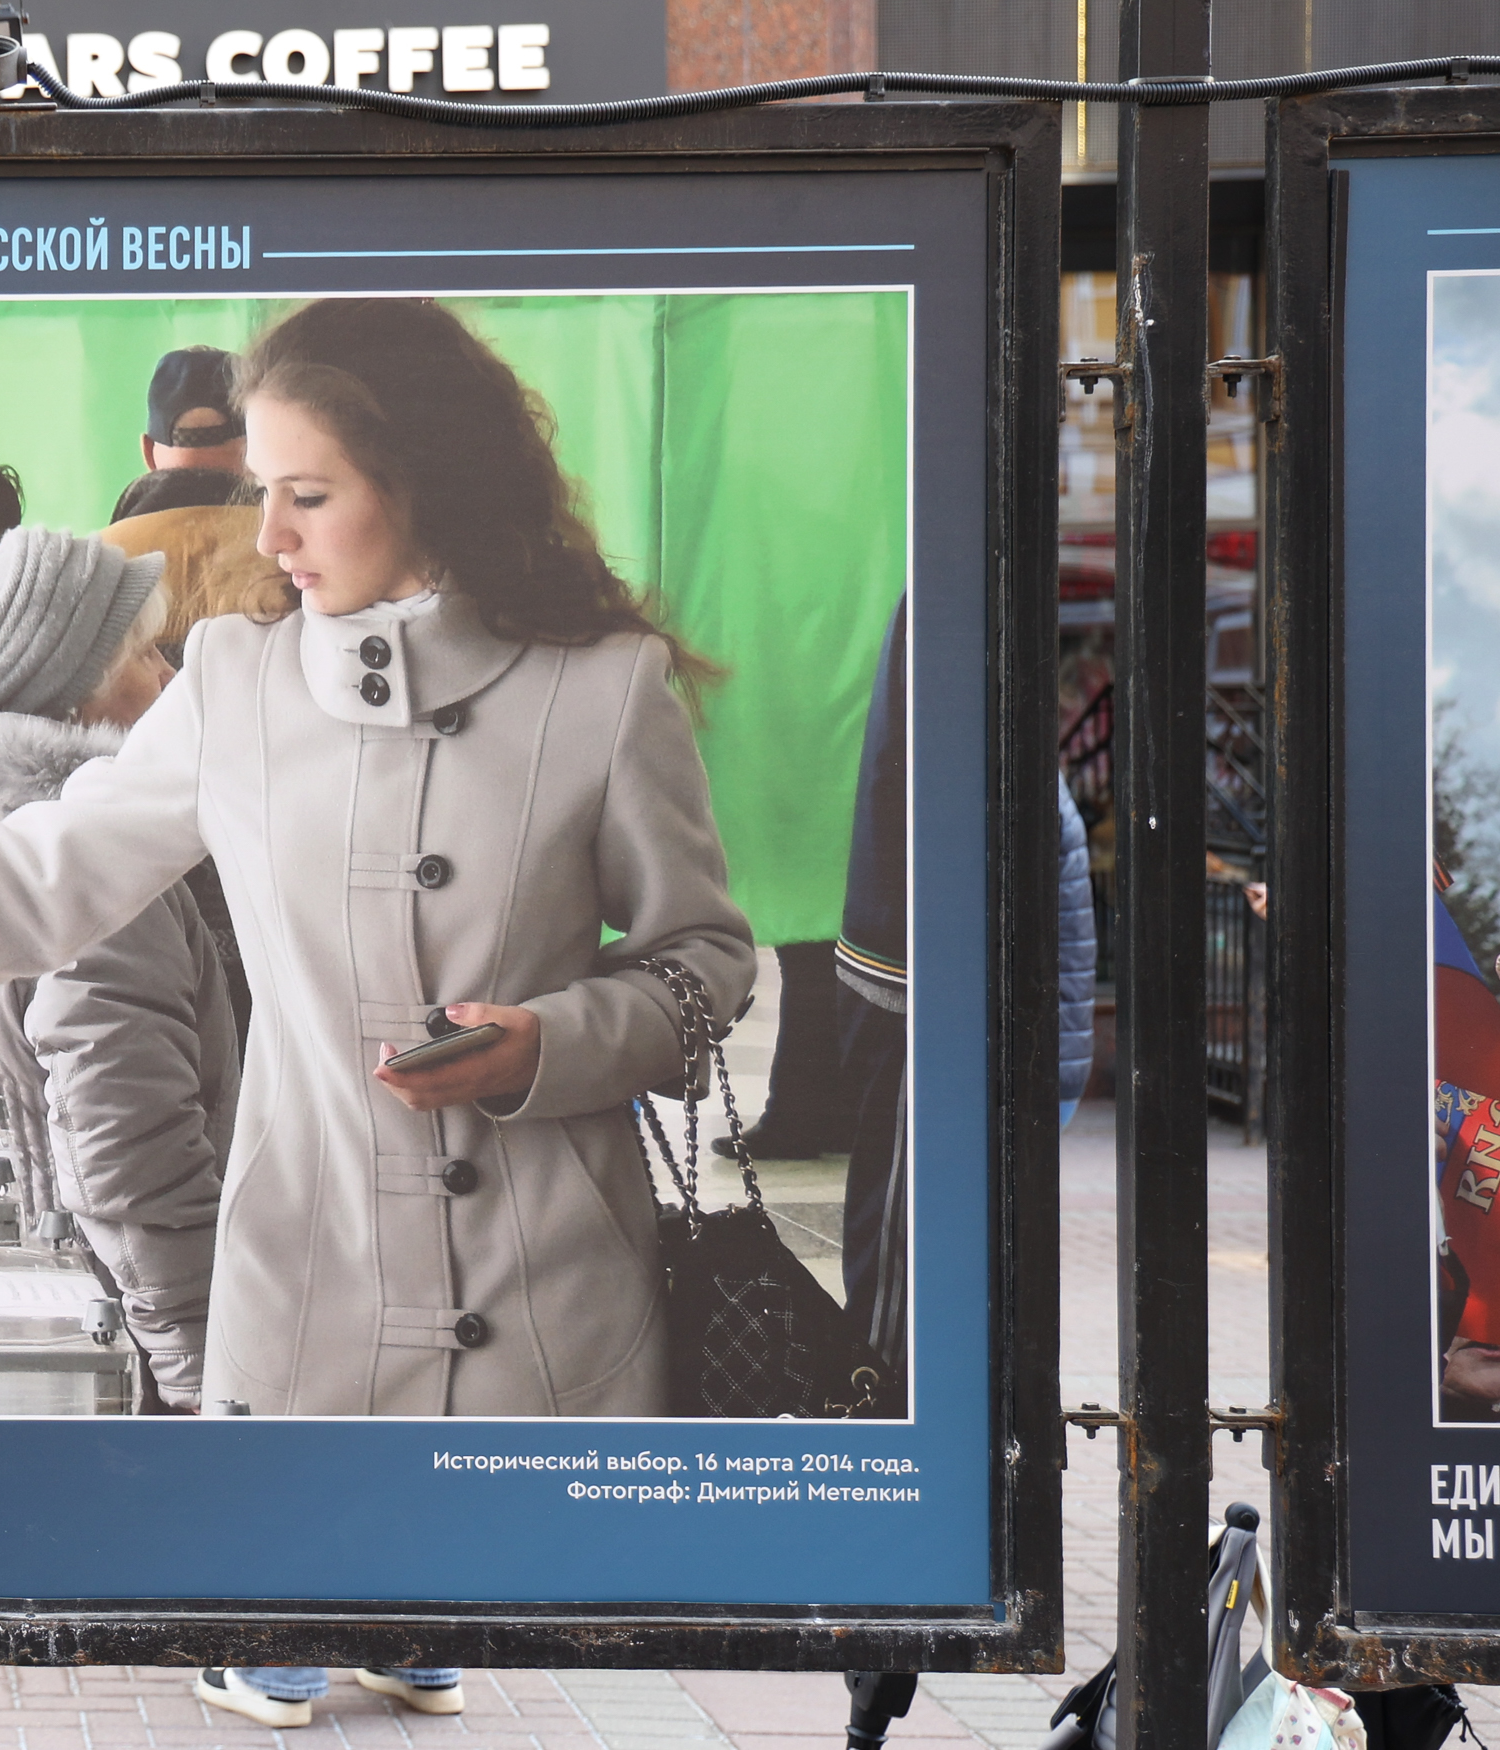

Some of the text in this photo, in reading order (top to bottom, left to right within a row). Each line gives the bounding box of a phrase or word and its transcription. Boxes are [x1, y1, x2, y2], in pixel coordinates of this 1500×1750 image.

[206, 24, 550, 93] COFFEE
[122, 225, 250, 271] ВЕСНЫ
[433, 1450, 920, 1477] Исторический выбор. 16 марта 2014 года.
[566, 1479, 920, 1505] Фотограф: Дмитрий Метелкин
[1431, 1518, 1494, 1560] МЫ
